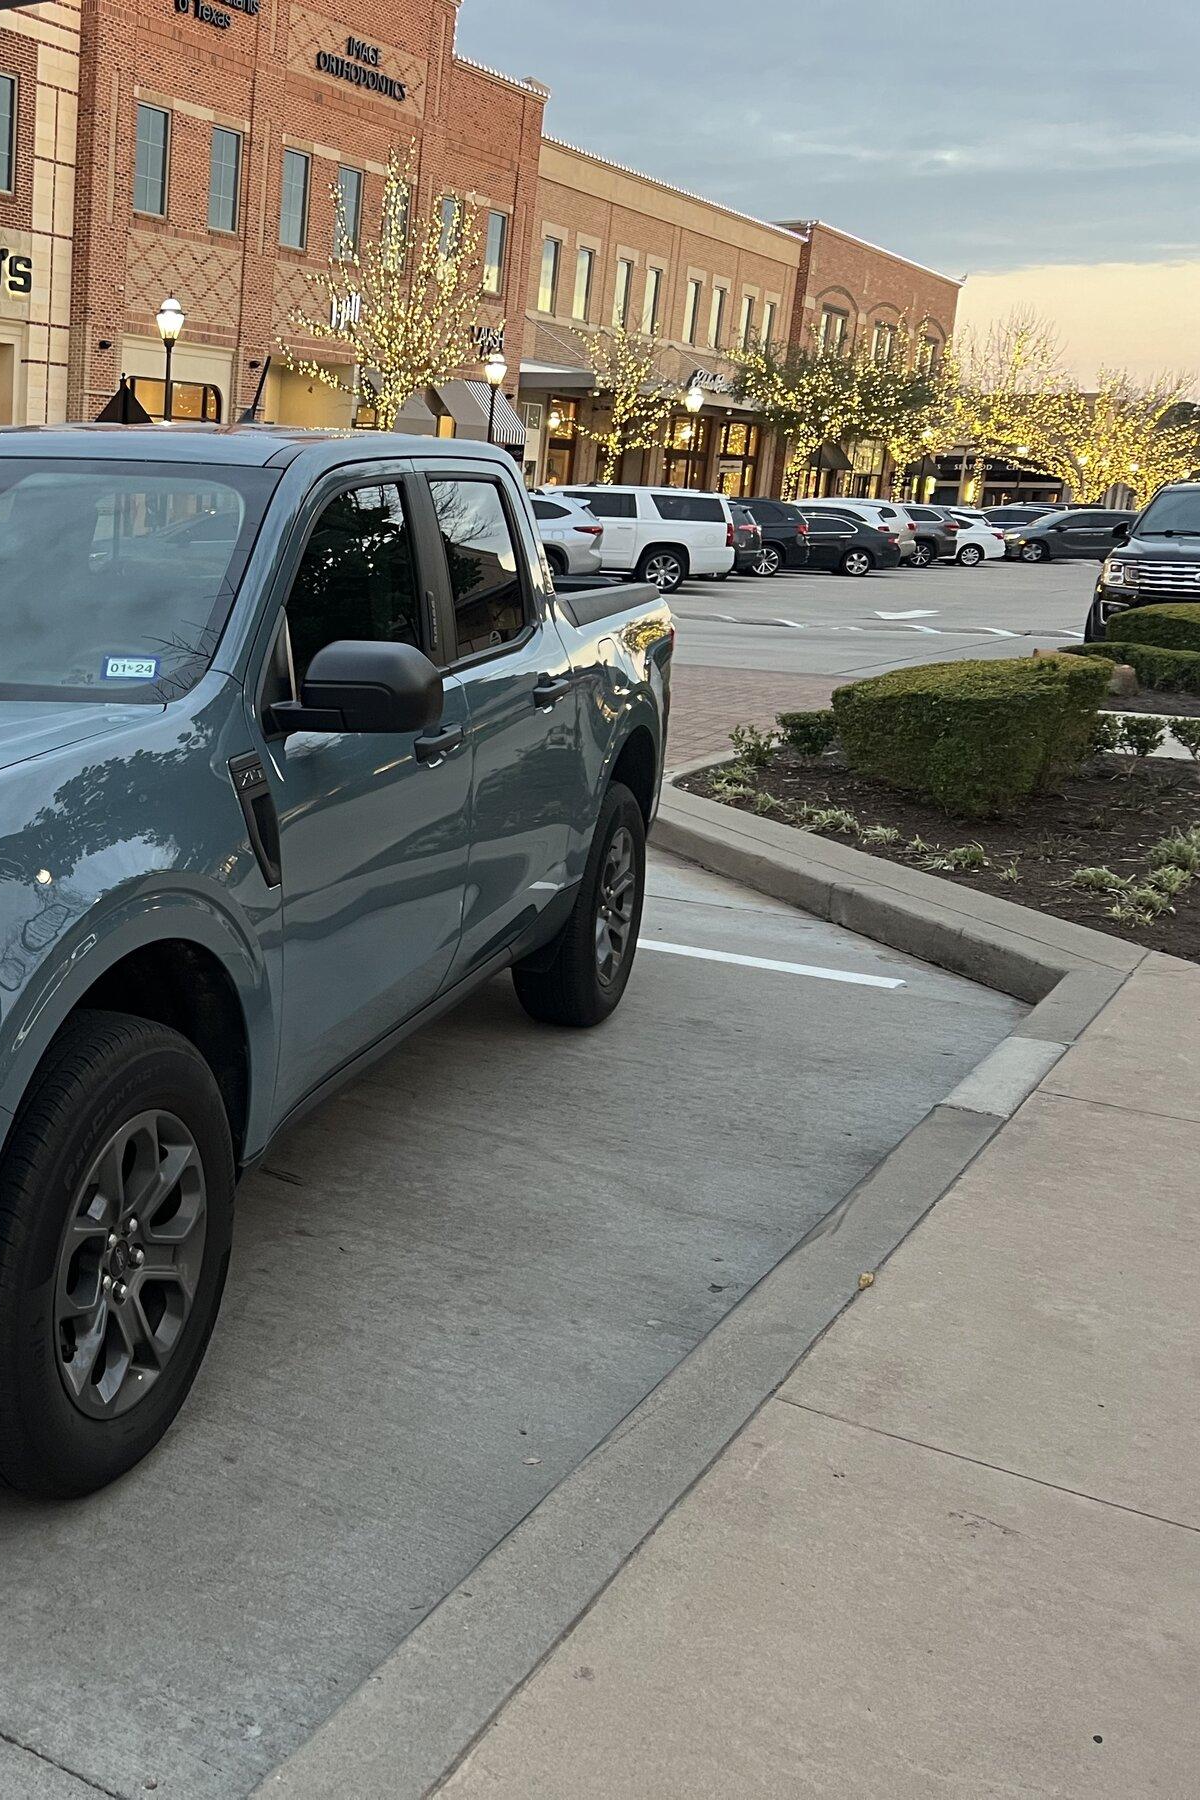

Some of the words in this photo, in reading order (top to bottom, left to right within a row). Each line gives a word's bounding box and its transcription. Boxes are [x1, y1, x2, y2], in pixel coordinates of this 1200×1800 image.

[193, 0, 232, 29] Texas
[347, 36, 382, 66] IMAGE
[316, 50, 406, 101] ORTHODONTICS
